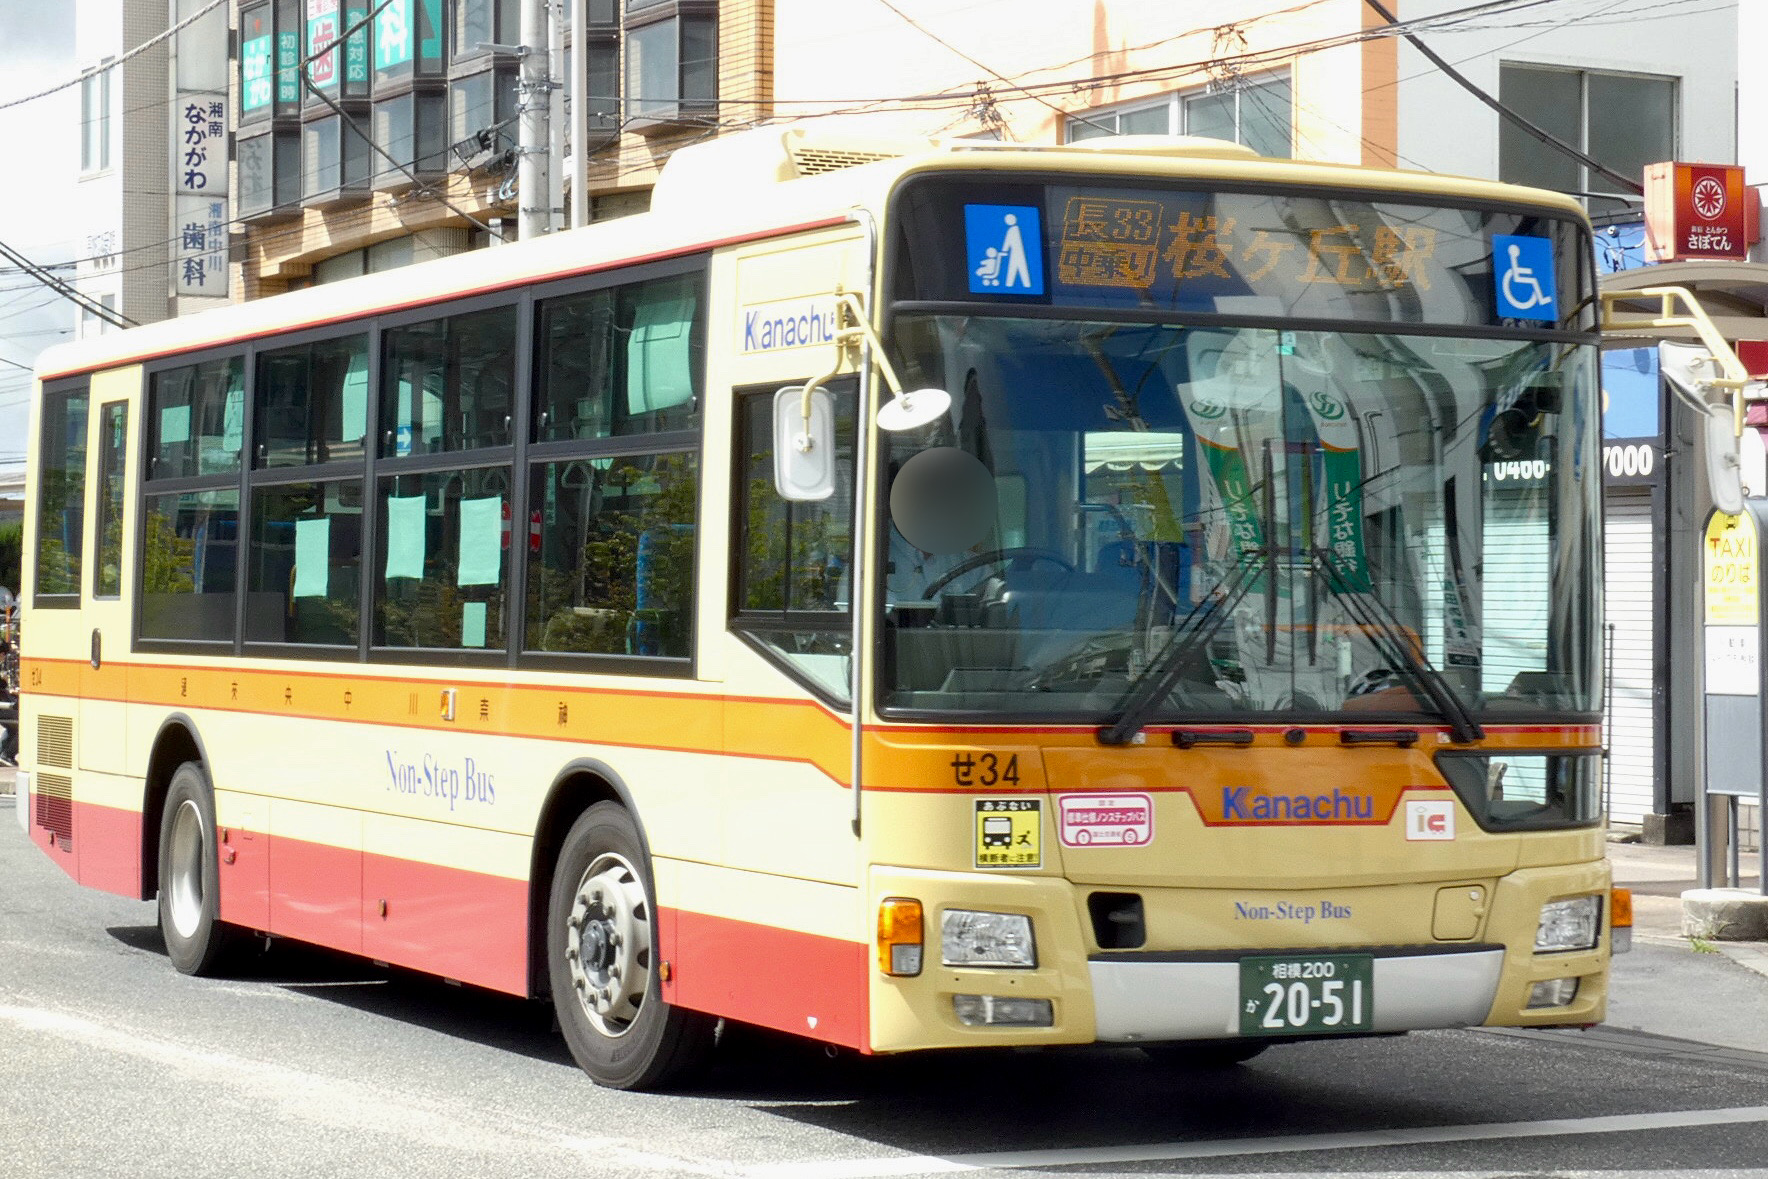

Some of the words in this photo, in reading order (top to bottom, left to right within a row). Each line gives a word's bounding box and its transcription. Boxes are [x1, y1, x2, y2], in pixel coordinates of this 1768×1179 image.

[208, 101, 224, 138] 湘南
[184, 103, 207, 190] なかがわ
[182, 222, 207, 287] 歯科
[1688, 234, 1732, 250] さぼてん
[744, 304, 834, 351] Kanachu
[1710, 537, 1751, 558] TAXI
[385, 749, 459, 812] Non-Step
[464, 757, 496, 806] Bus
[951, 752, 1021, 786] せ34
[983, 801, 1032, 811] あぶない
[1222, 786, 1374, 820] Kanachu
[1234, 901, 1316, 924] Non-Step
[1321, 901, 1353, 919] Bus
[1262, 980, 1362, 1028] 20-51
